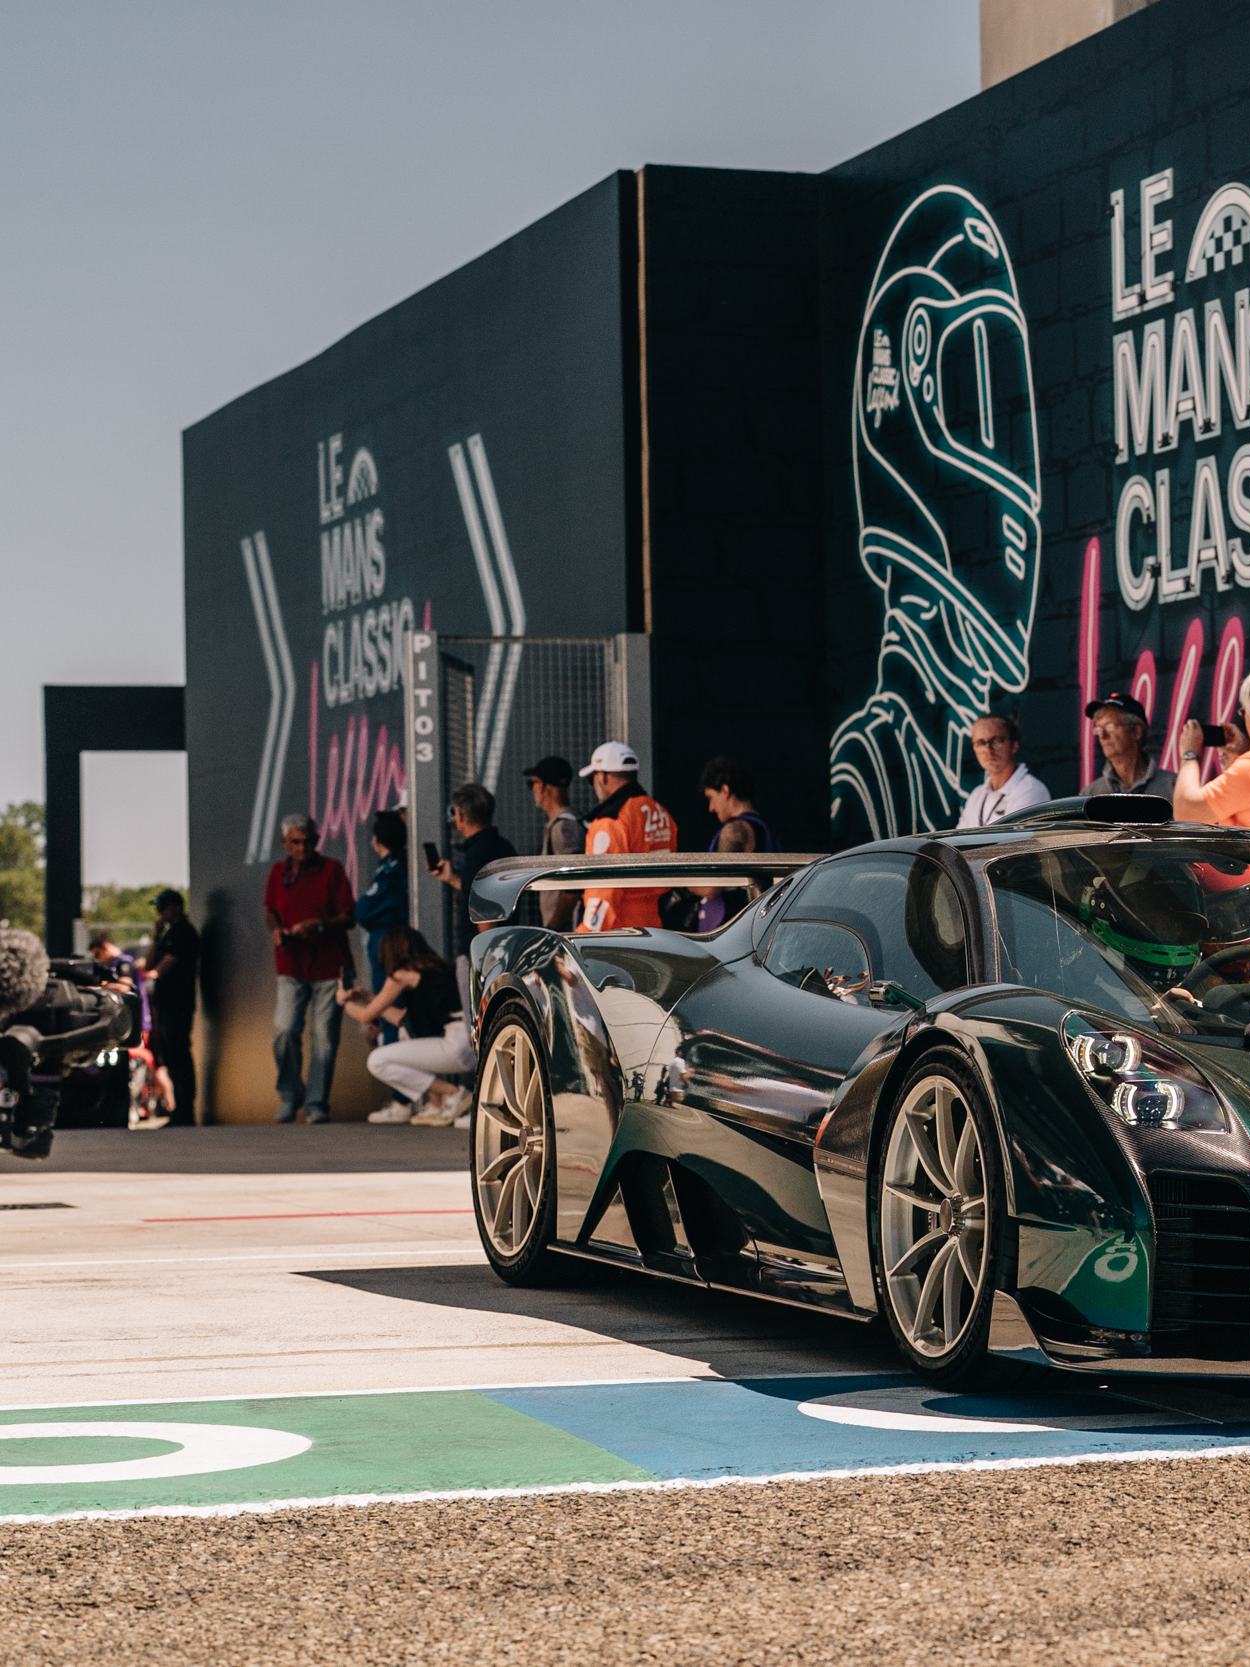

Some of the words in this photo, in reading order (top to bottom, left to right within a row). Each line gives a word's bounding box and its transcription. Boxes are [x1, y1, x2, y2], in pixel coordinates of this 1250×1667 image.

[1110, 168, 1174, 322] LE
[317, 432, 345, 525] LE
[320, 507, 386, 616] MANS
